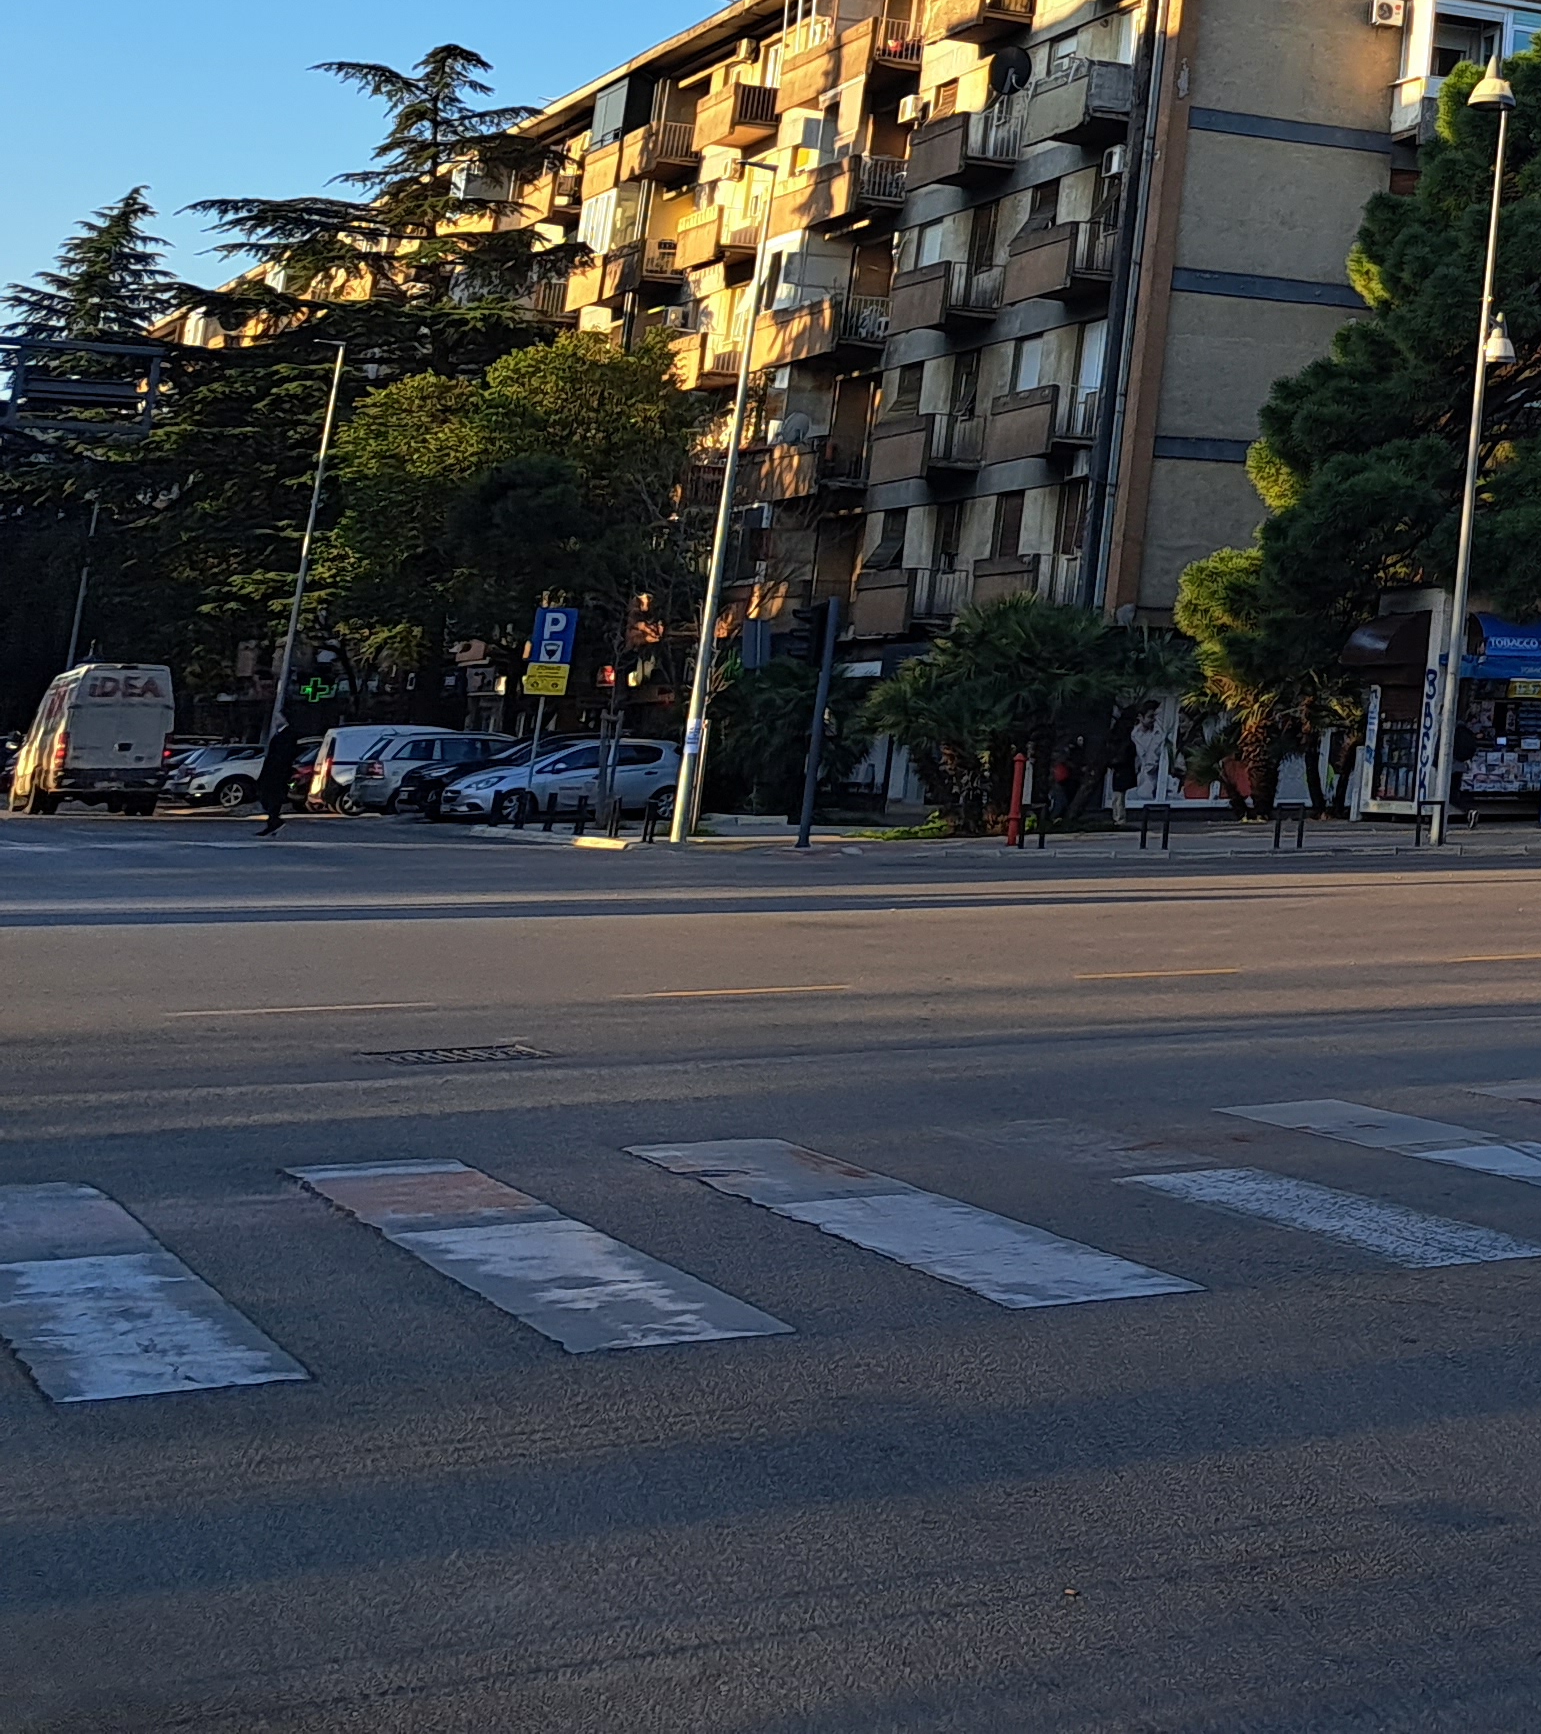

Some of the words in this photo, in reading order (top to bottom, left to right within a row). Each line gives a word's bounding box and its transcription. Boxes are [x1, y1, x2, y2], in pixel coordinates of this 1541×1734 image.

[543, 612, 567, 640] P
[1489, 636, 1539, 649] TOBACCO
[88, 676, 166, 698] iDEA
